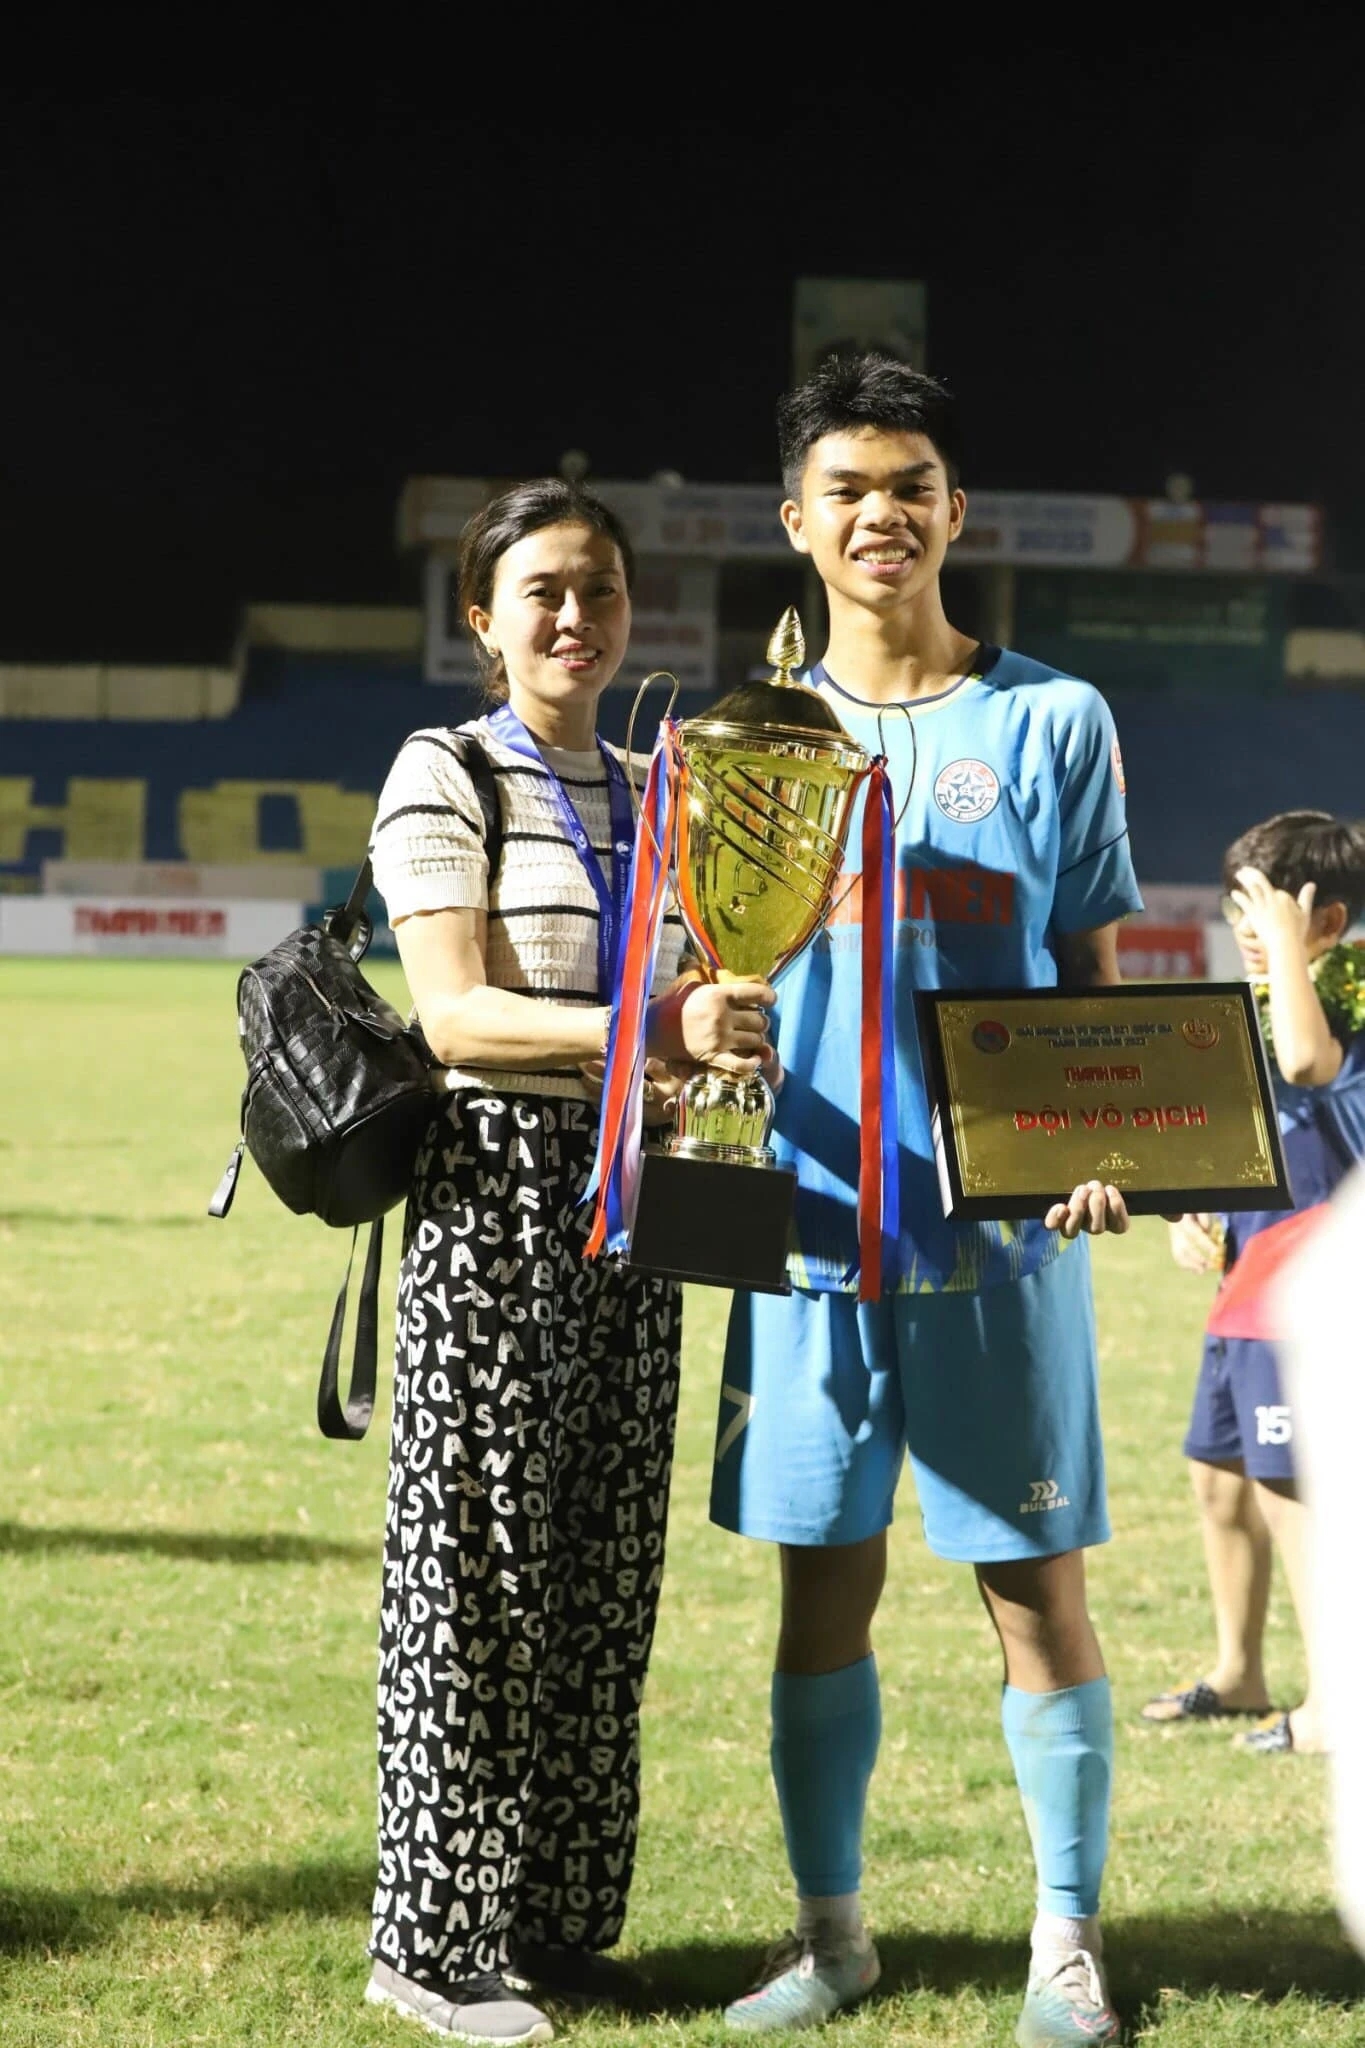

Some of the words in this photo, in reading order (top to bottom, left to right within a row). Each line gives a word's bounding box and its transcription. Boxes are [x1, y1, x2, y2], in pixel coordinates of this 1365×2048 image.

[1013, 1104, 1071, 1136] ĐỘI
[1079, 1102, 1125, 1128] VÔ
[1131, 1104, 1208, 1133] ĐỊCH
[1255, 1405, 1292, 1446] 15
